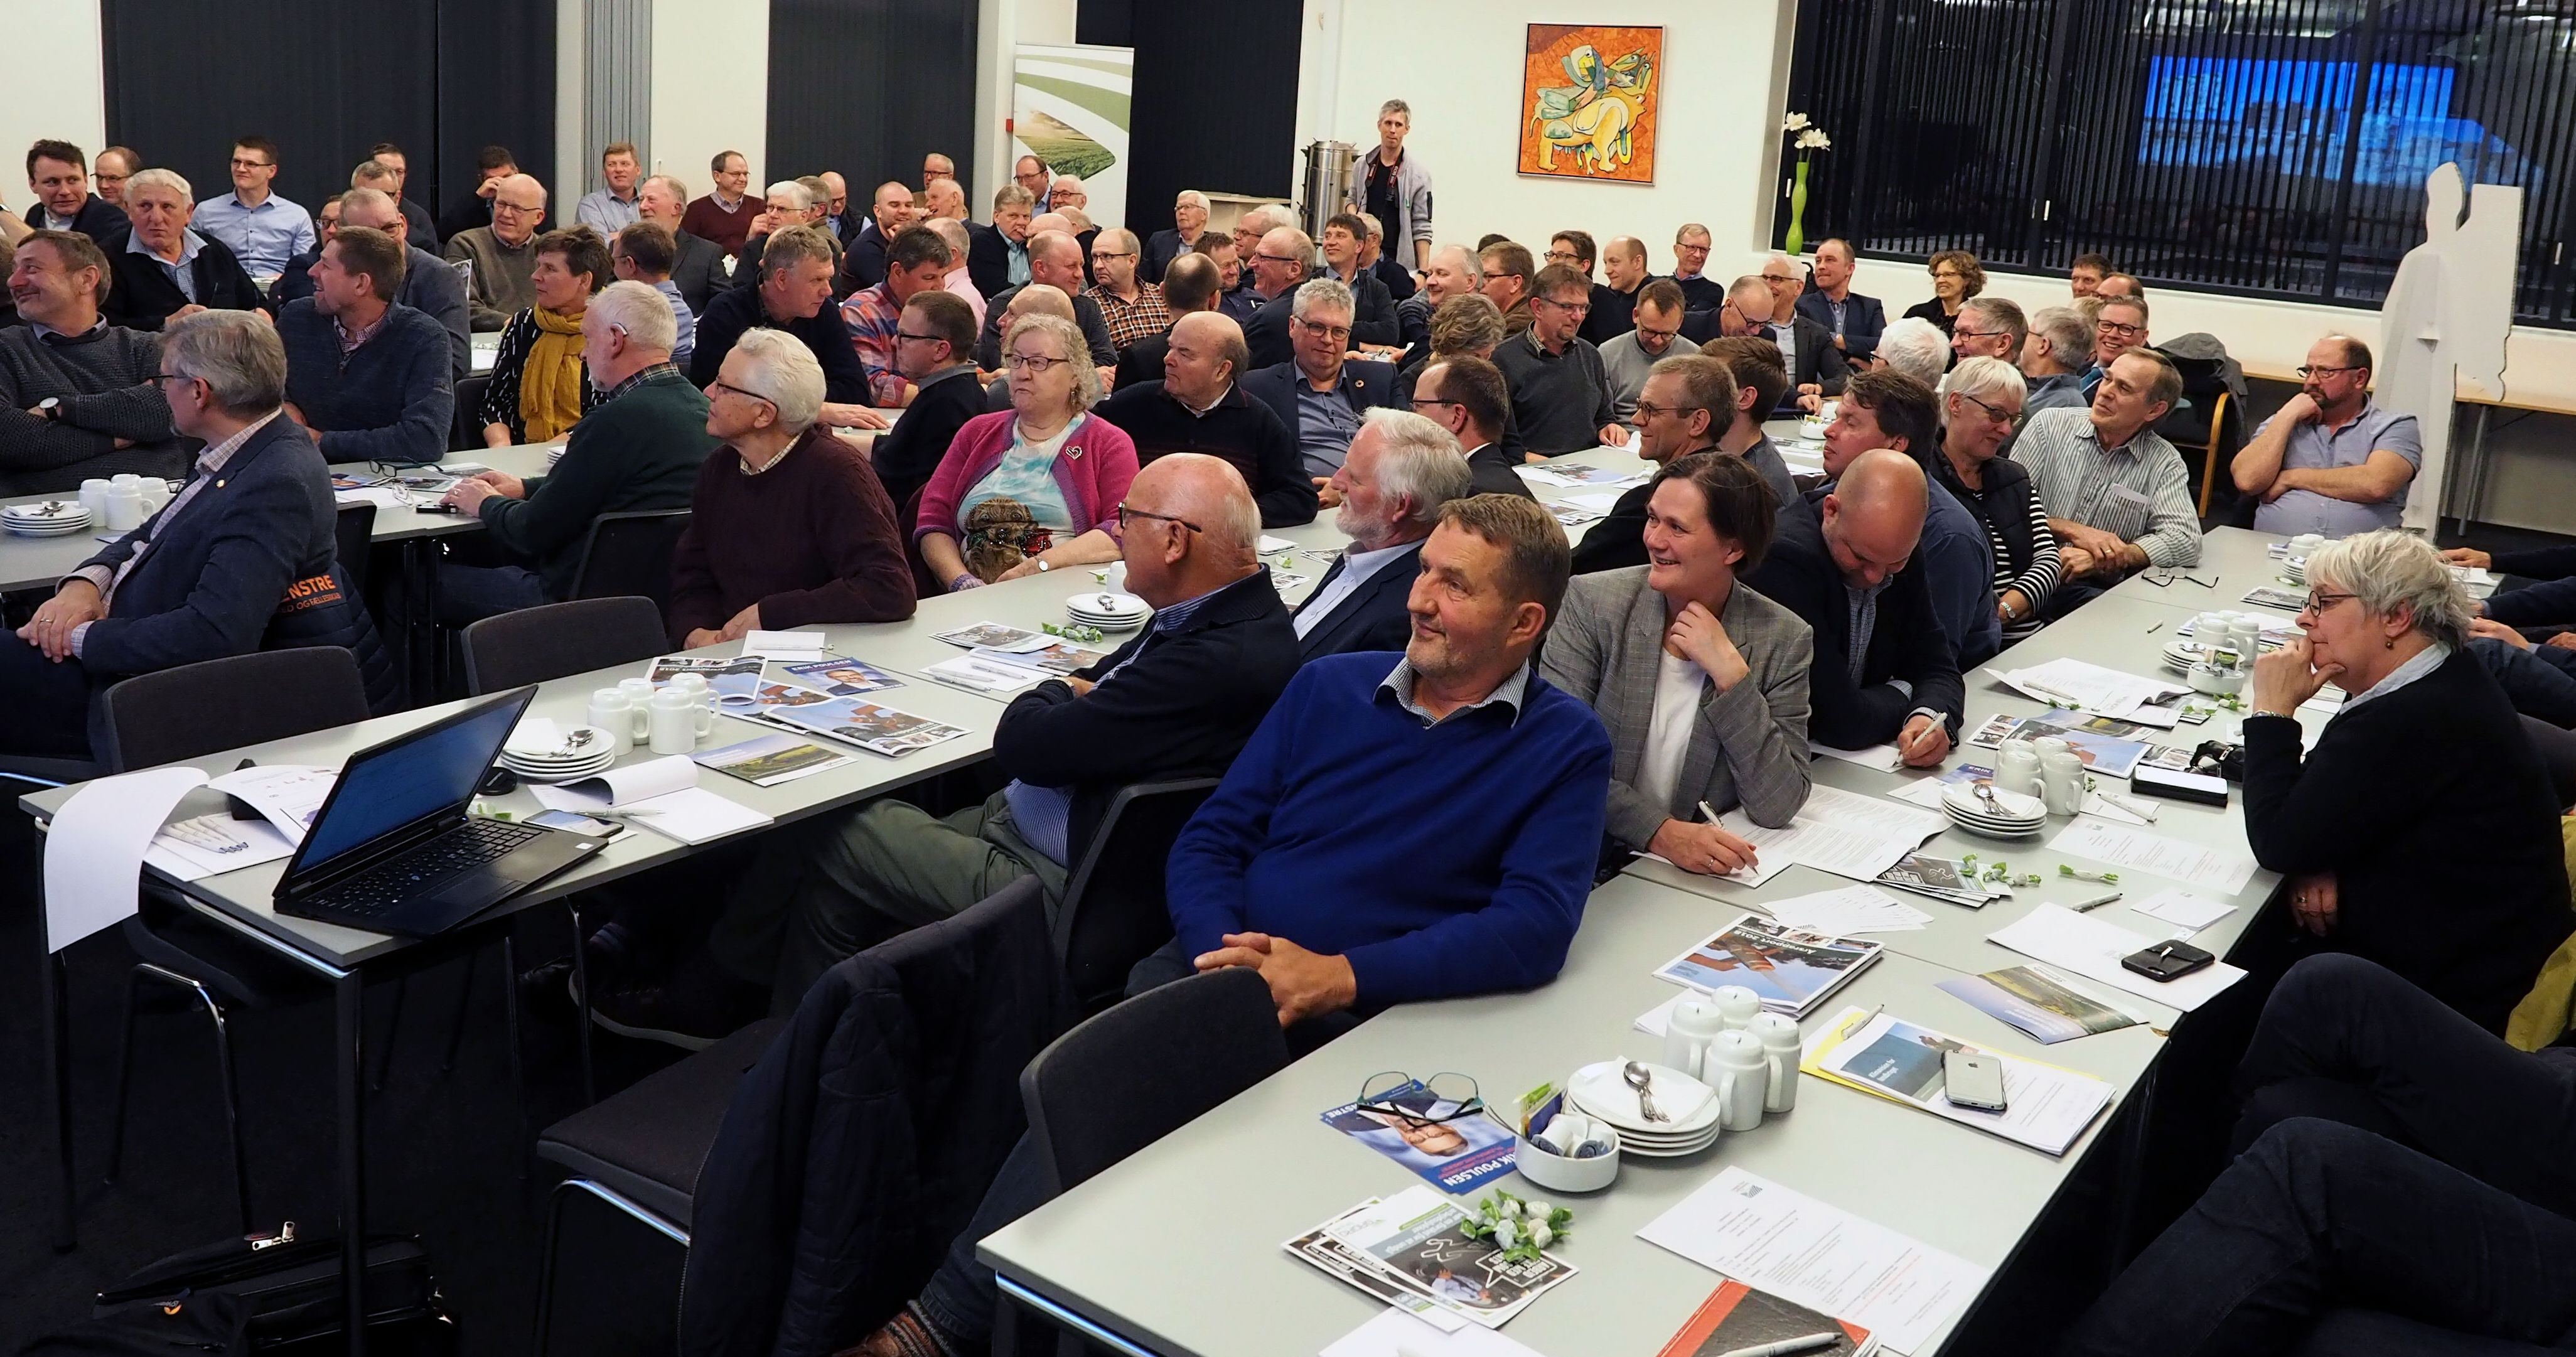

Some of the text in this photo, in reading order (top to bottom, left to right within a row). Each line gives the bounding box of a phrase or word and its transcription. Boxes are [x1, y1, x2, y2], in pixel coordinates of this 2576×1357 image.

[286, 574, 336, 599] NSTRE
[814, 660, 852, 668] POULSEN
[1443, 1159, 1501, 1186] POULSEN
